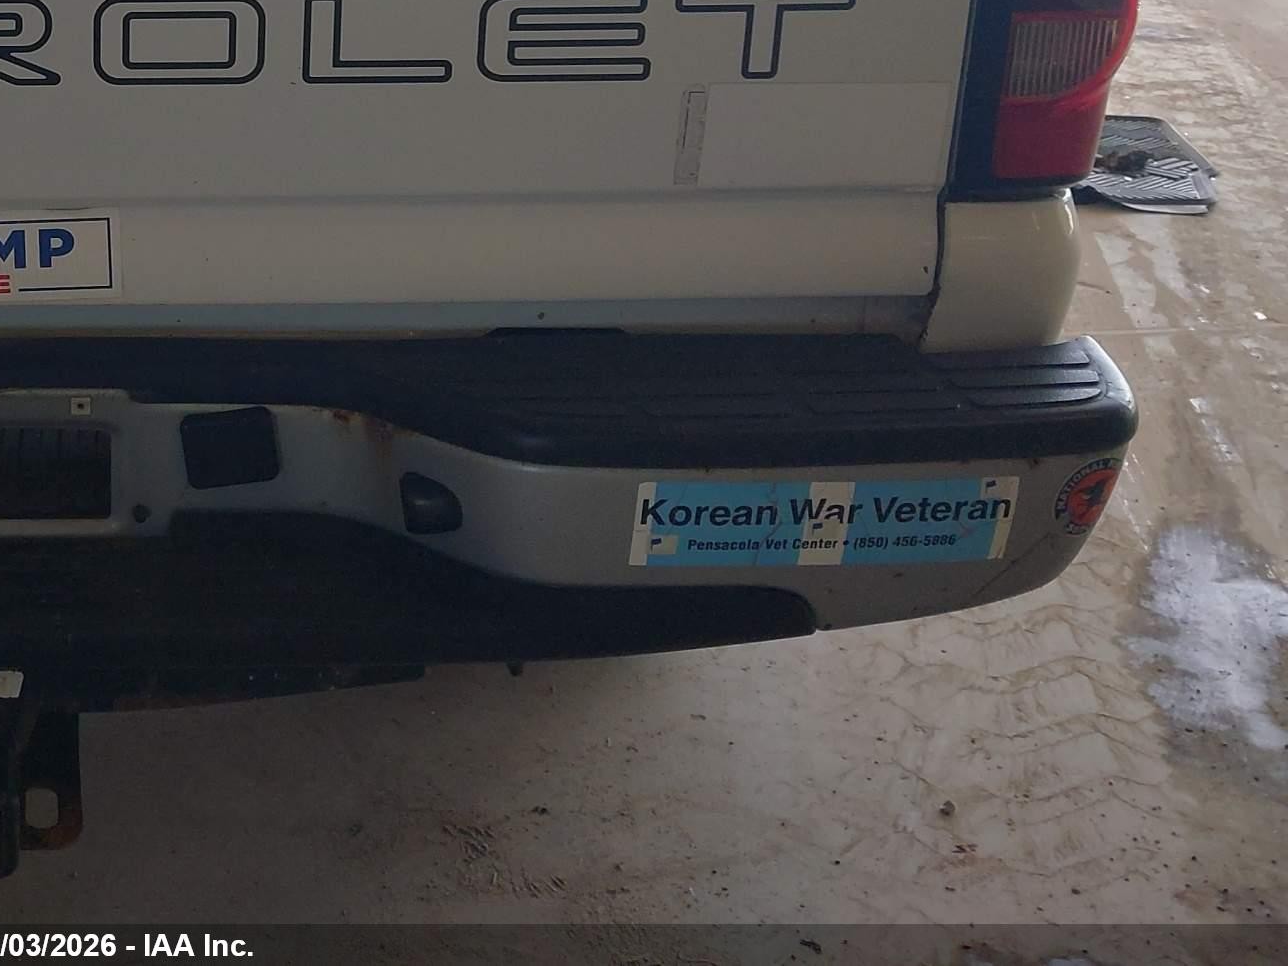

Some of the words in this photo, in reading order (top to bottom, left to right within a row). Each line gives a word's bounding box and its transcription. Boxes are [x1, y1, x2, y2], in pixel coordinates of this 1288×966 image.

[640, 498, 778, 527] Korean
[790, 497, 863, 525] War
[873, 496, 1011, 524] Veteran
[687, 538, 760, 551] Pensacola
[765, 537, 788, 550] Vet
[791, 536, 839, 550] Center
[853, 536, 889, 551] (850)
